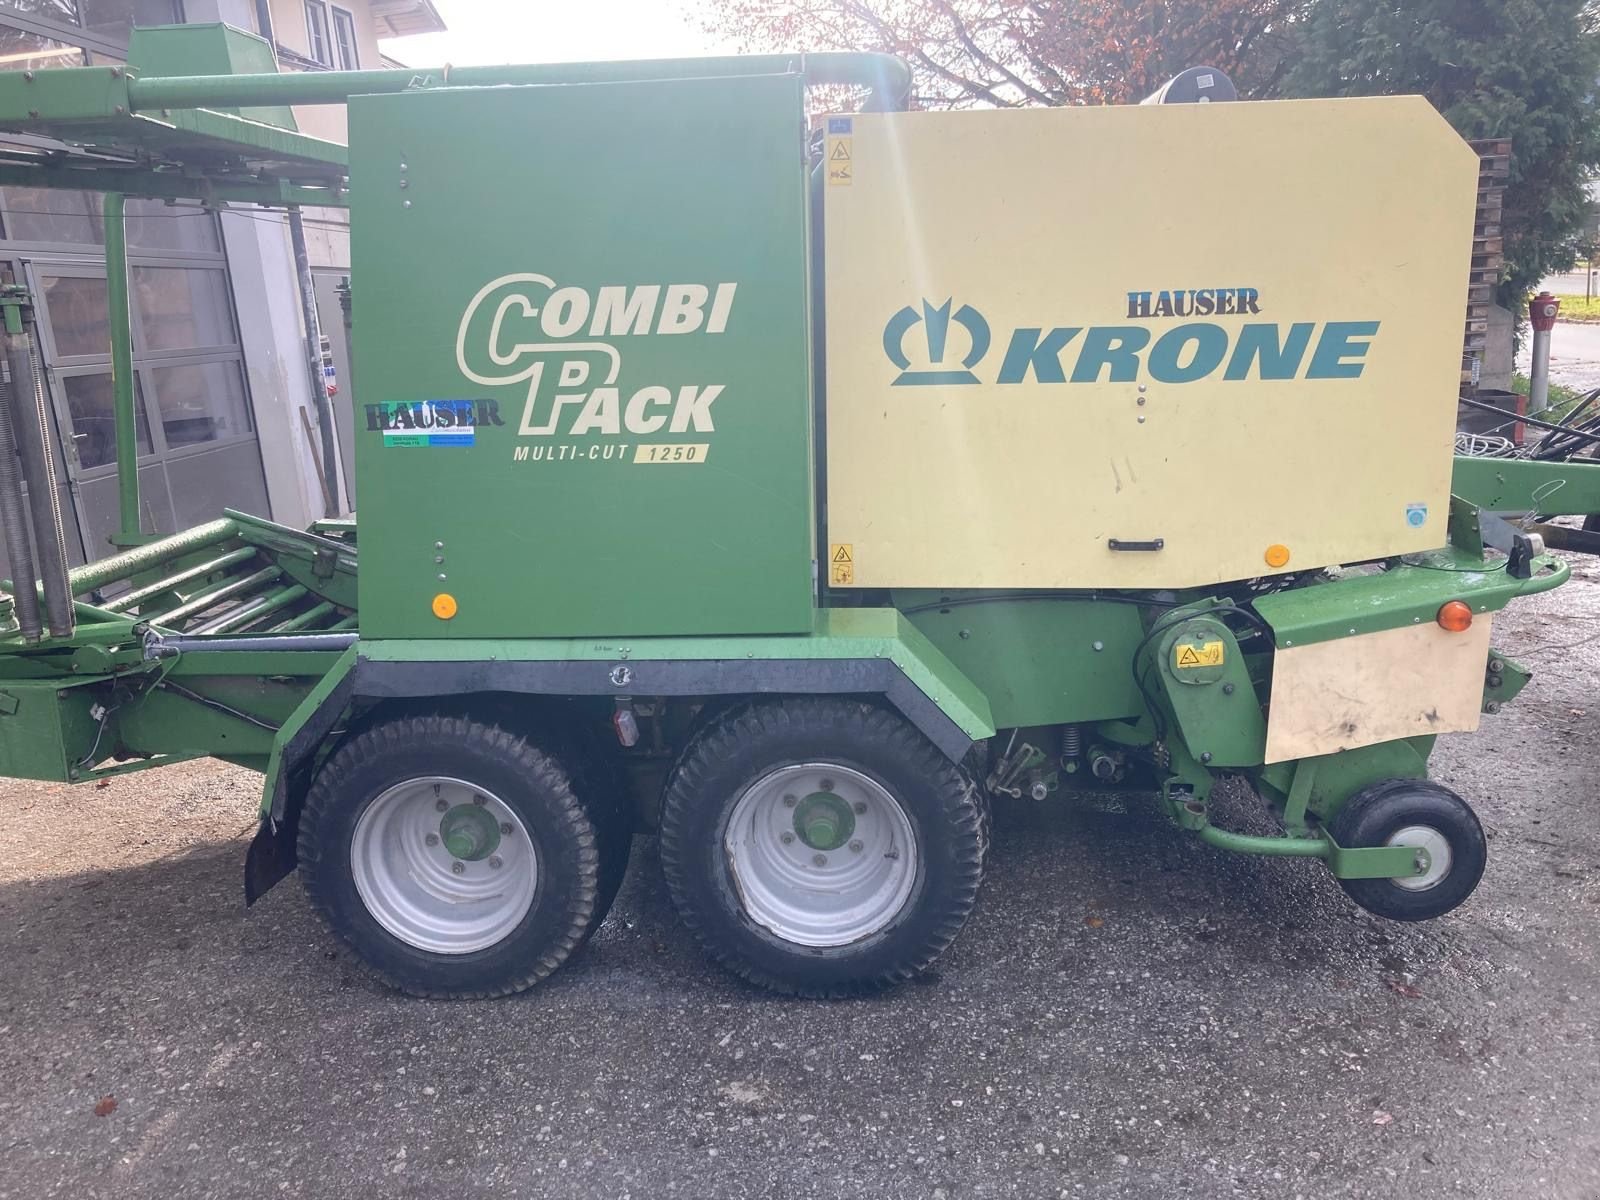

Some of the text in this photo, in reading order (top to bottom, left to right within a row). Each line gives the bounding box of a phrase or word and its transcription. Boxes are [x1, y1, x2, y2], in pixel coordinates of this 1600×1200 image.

[1127, 287, 1262, 318] HAUSER
[456, 273, 737, 385] COMBI
[996, 320, 1381, 384] KRONE
[517, 342, 726, 435] PACK
[364, 398, 506, 431] HAUSER
[513, 444, 696, 461] MULTI-CUT 1250
